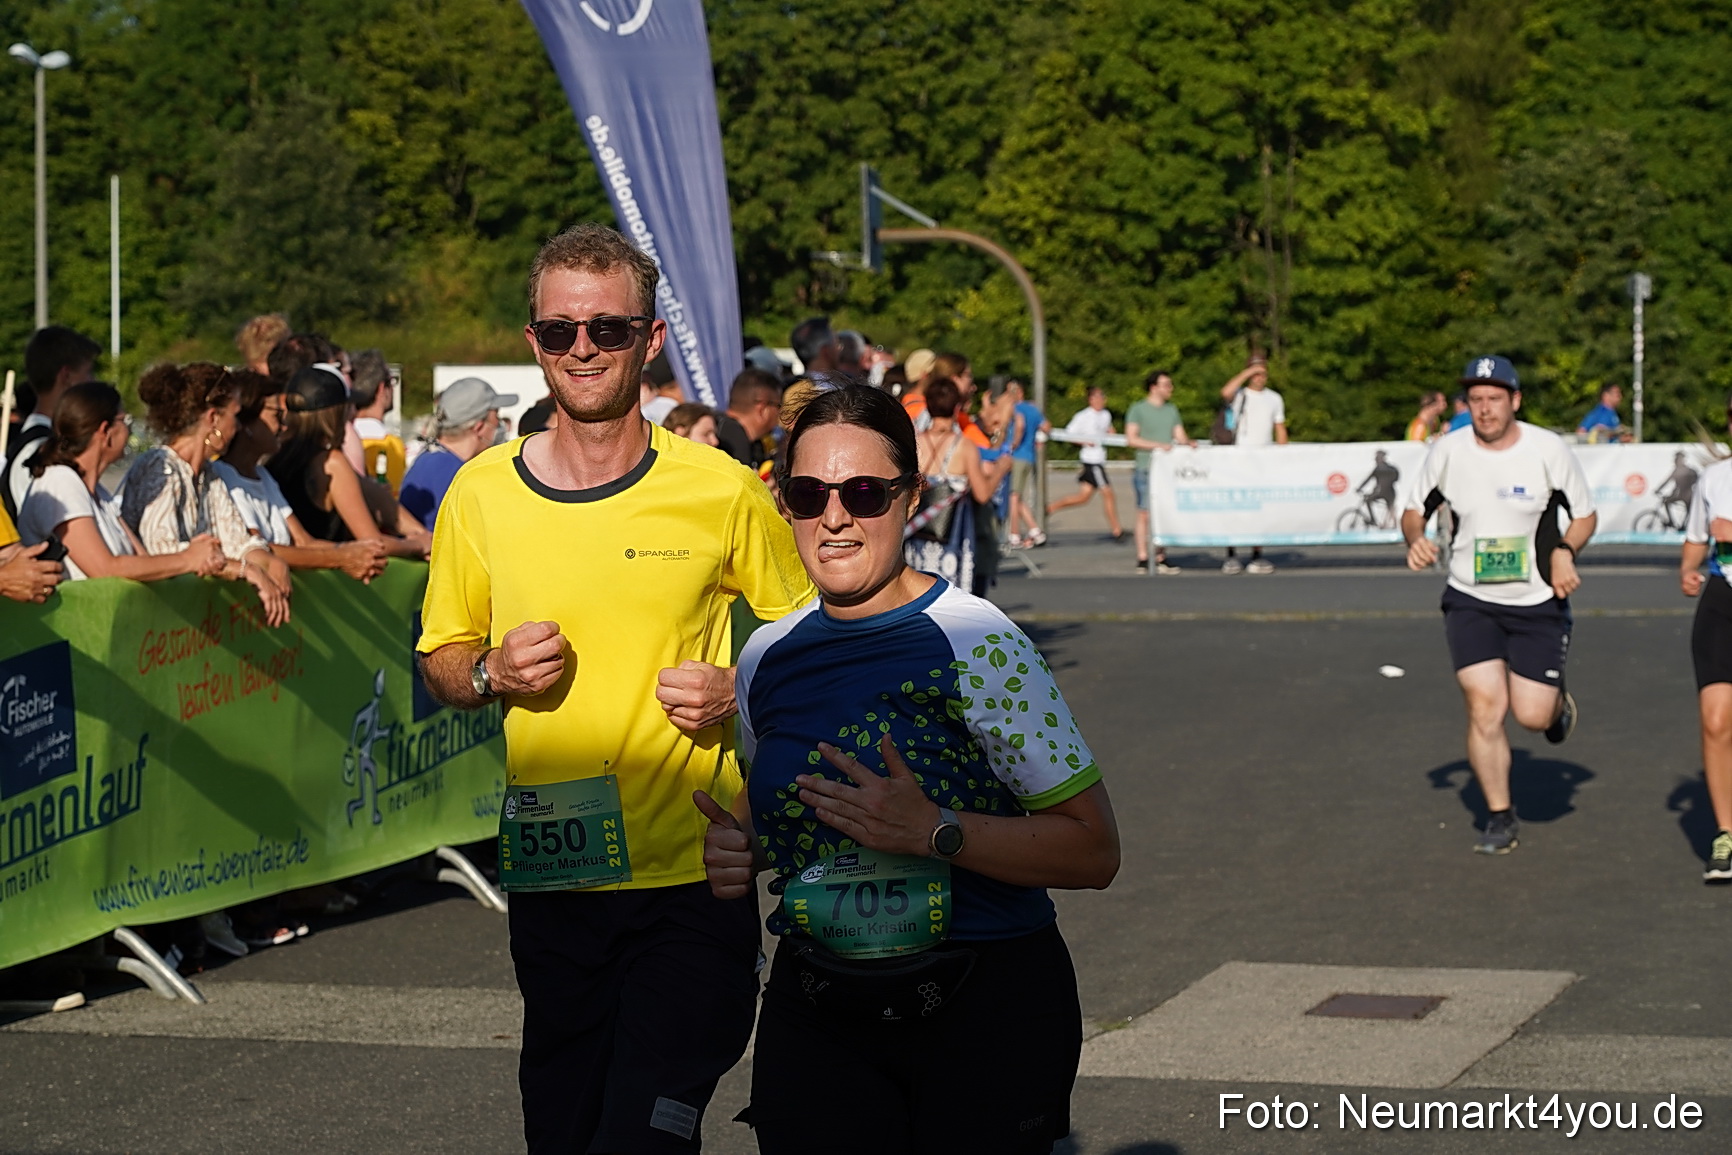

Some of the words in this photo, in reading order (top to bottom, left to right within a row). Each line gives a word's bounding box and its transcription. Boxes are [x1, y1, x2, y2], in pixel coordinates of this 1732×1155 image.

[638, 549, 690, 557] SPANGLER
[1487, 551, 1516, 566] 529
[138, 600, 223, 675] Gesunde
[7, 690, 58, 726] Fischer
[177, 661, 236, 723] laufen
[387, 698, 503, 786] firmenlau
[389, 773, 445, 809] neumarkt
[517, 802, 554, 814] Firmenlauf
[530, 809, 555, 818] neumarkt
[502, 834, 512, 870] RUN
[520, 818, 587, 857] 550
[603, 818, 622, 868] 2022
[0, 856, 50, 900] markt
[512, 860, 555, 874] Pflieger
[558, 855, 607, 870] Markus
[826, 862, 877, 876] Firmenlauf
[846, 870, 876, 878] neumarkt
[825, 879, 909, 921] 705
[927, 881, 943, 934] 2022
[822, 925, 863, 939] Meier
[867, 920, 917, 935] Kristin
